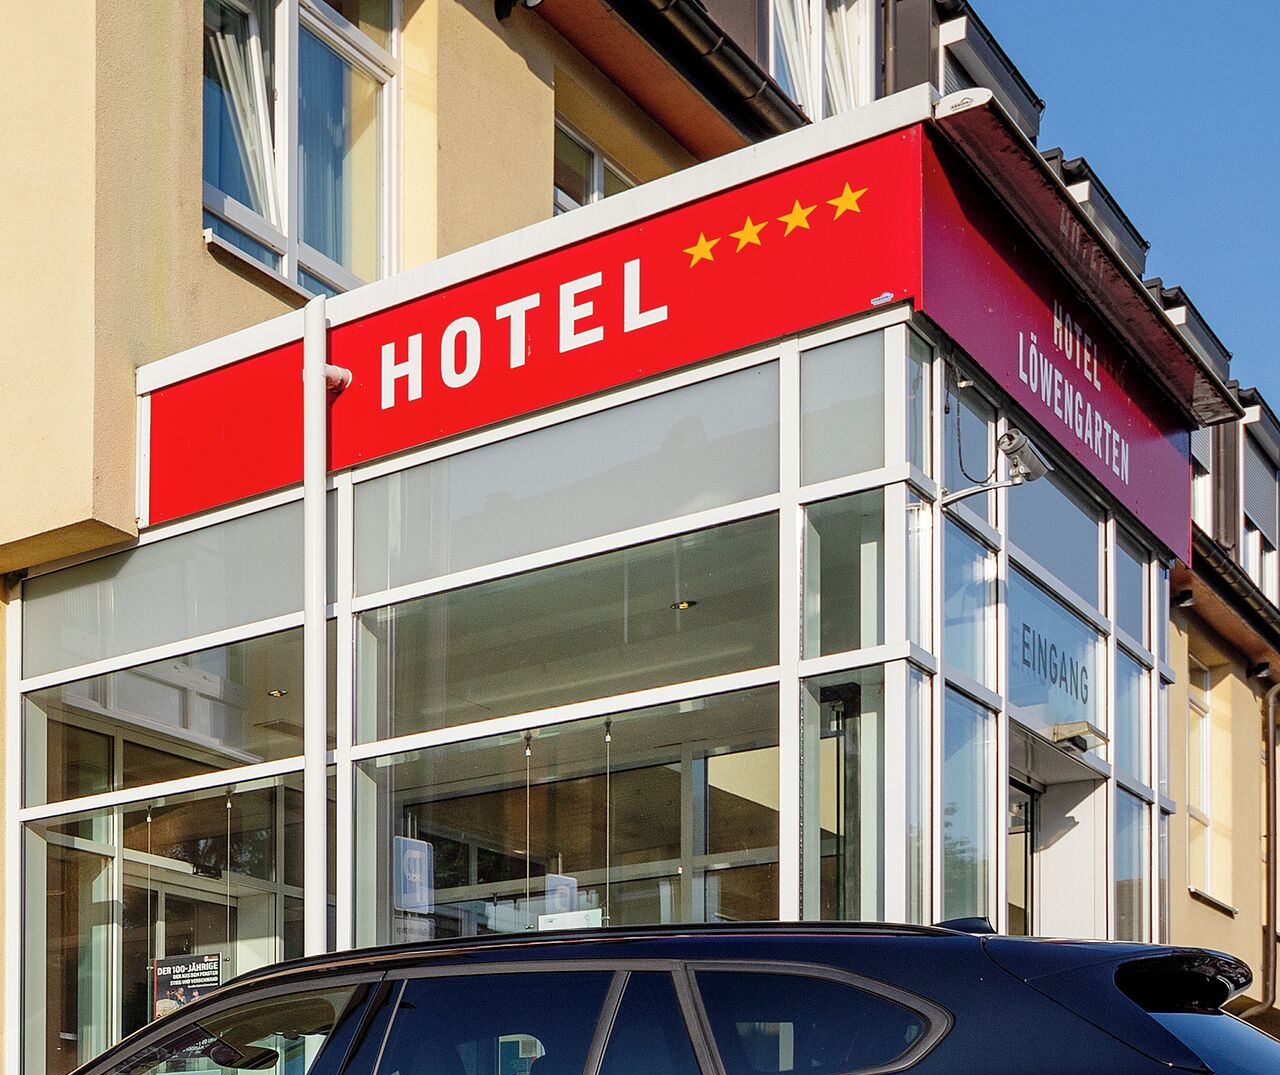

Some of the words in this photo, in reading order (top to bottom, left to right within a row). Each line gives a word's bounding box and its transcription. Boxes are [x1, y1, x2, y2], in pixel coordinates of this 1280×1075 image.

[380, 257, 669, 411] HOTEL
[1053, 299, 1102, 392] HOTEL
[1018, 331, 1130, 486] LÖWENGARTEN
[1021, 623, 1090, 706] EINGANG
[157, 966, 171, 976] DER
